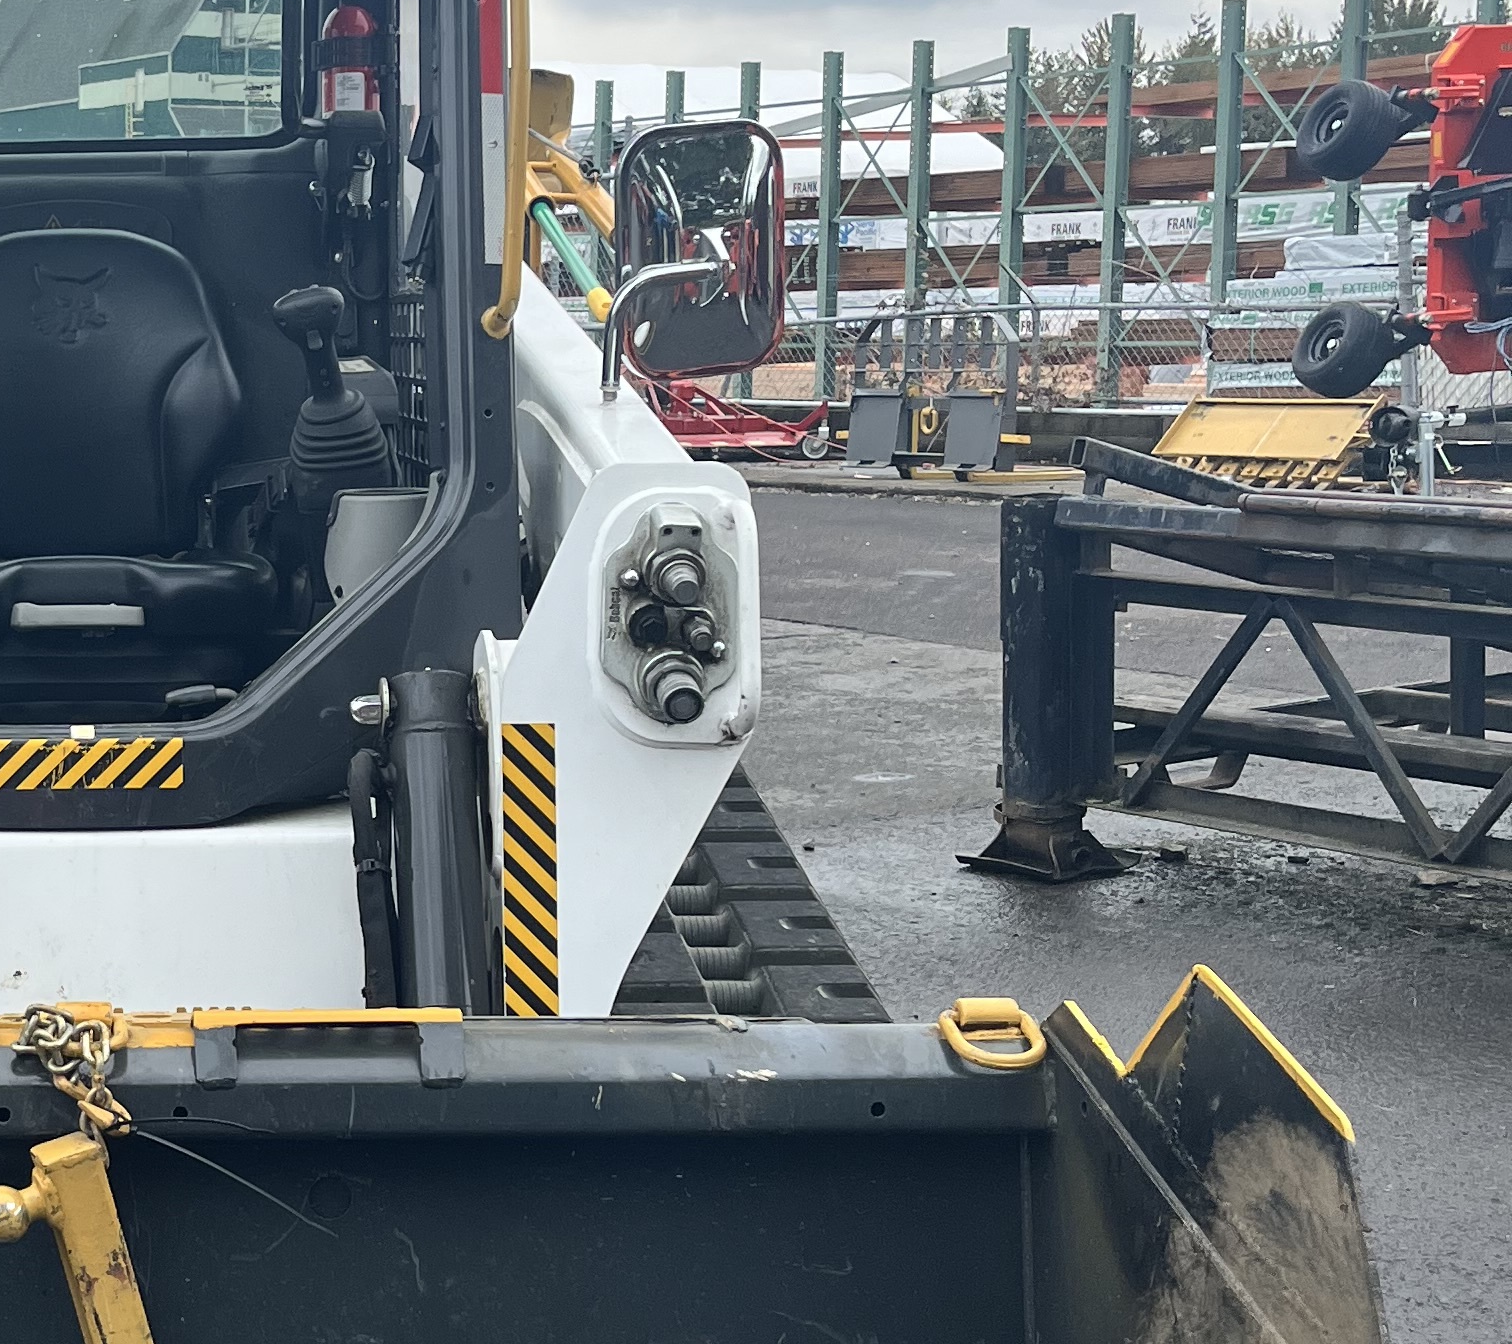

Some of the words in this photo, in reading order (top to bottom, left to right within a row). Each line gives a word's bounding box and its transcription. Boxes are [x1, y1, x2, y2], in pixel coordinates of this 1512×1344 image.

[792, 181, 818, 194] FRANK
[1051, 222, 1082, 235] FRANK
[1272, 286, 1307, 297] WOOD
[1342, 281, 1399, 294] EXTERIOR
[1021, 320, 1050, 332] FRNK
